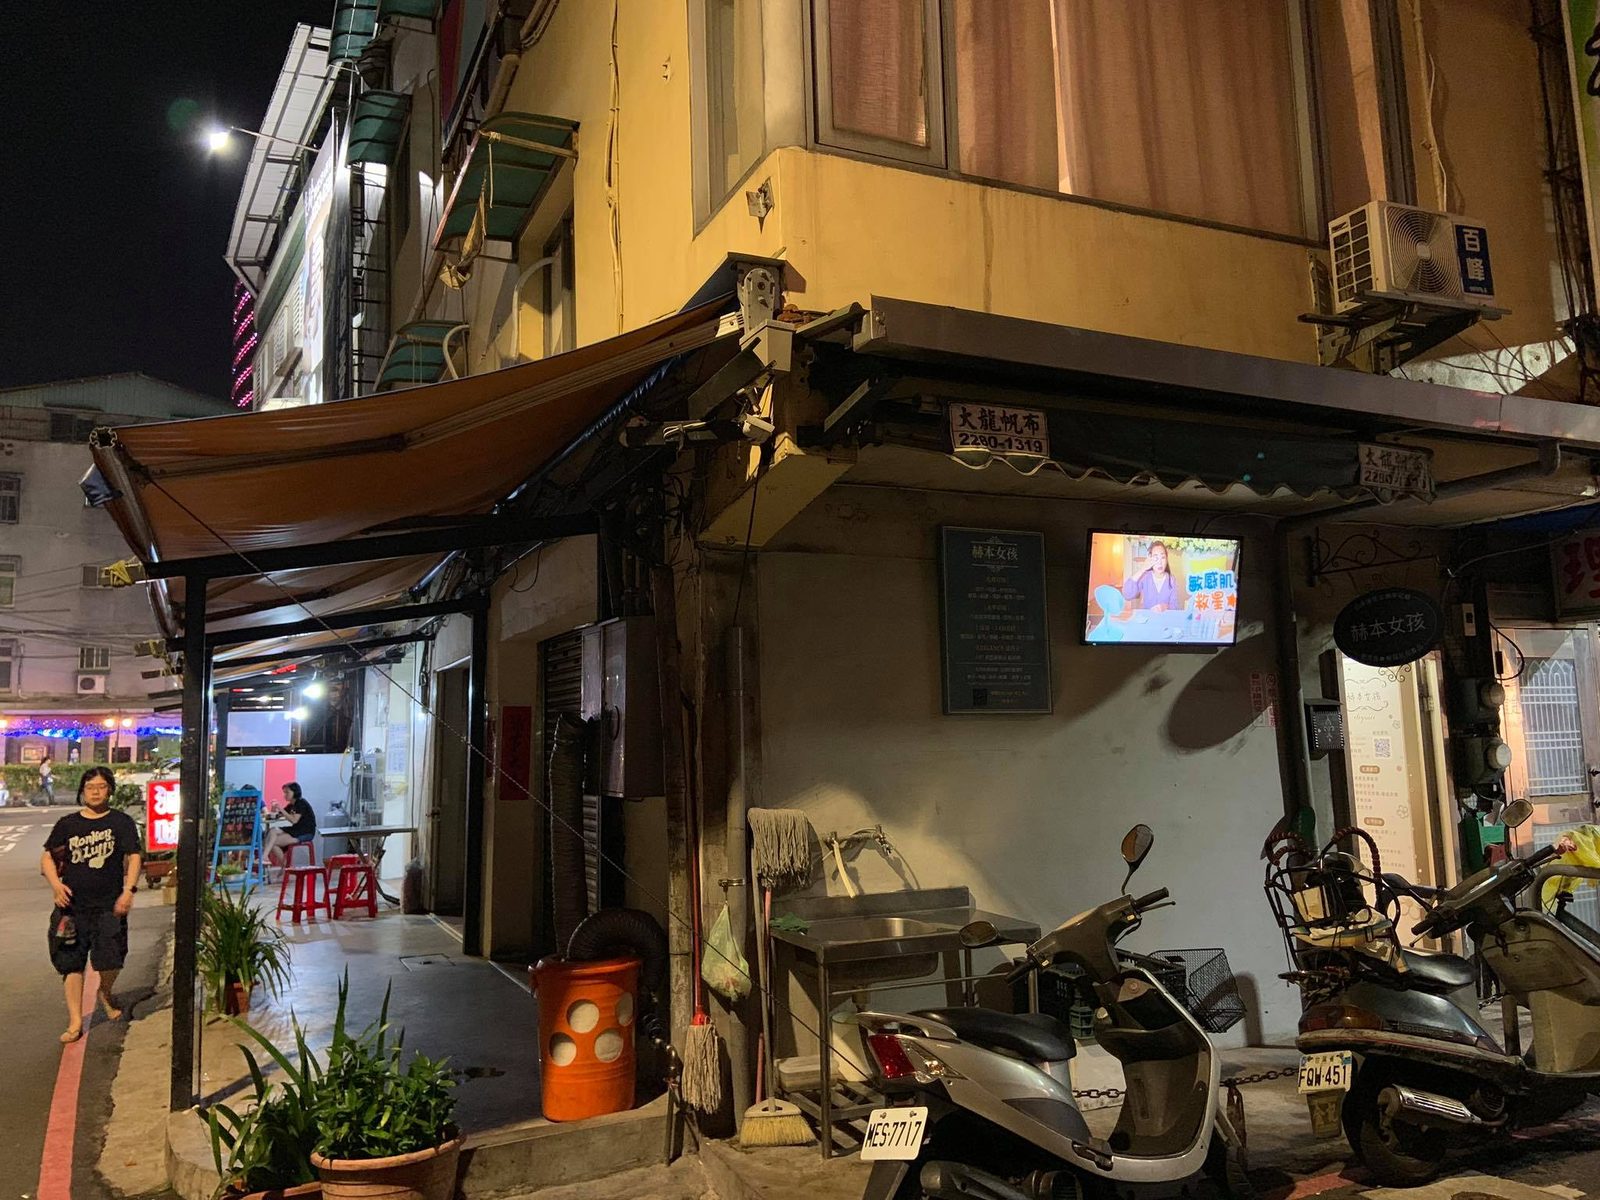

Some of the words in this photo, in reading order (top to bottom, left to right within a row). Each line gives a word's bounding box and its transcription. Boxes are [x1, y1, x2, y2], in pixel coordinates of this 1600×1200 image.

[958, 406, 1040, 435] 大龍帆布
[958, 433, 1043, 452] 2280-1319
[972, 545, 1018, 560] 赫本女孩
[1188, 572, 1234, 592] 敏感肌
[1194, 592, 1224, 610] 救星
[1351, 612, 1426, 642] 赫本女孩
[69, 828, 112, 851] Monkey
